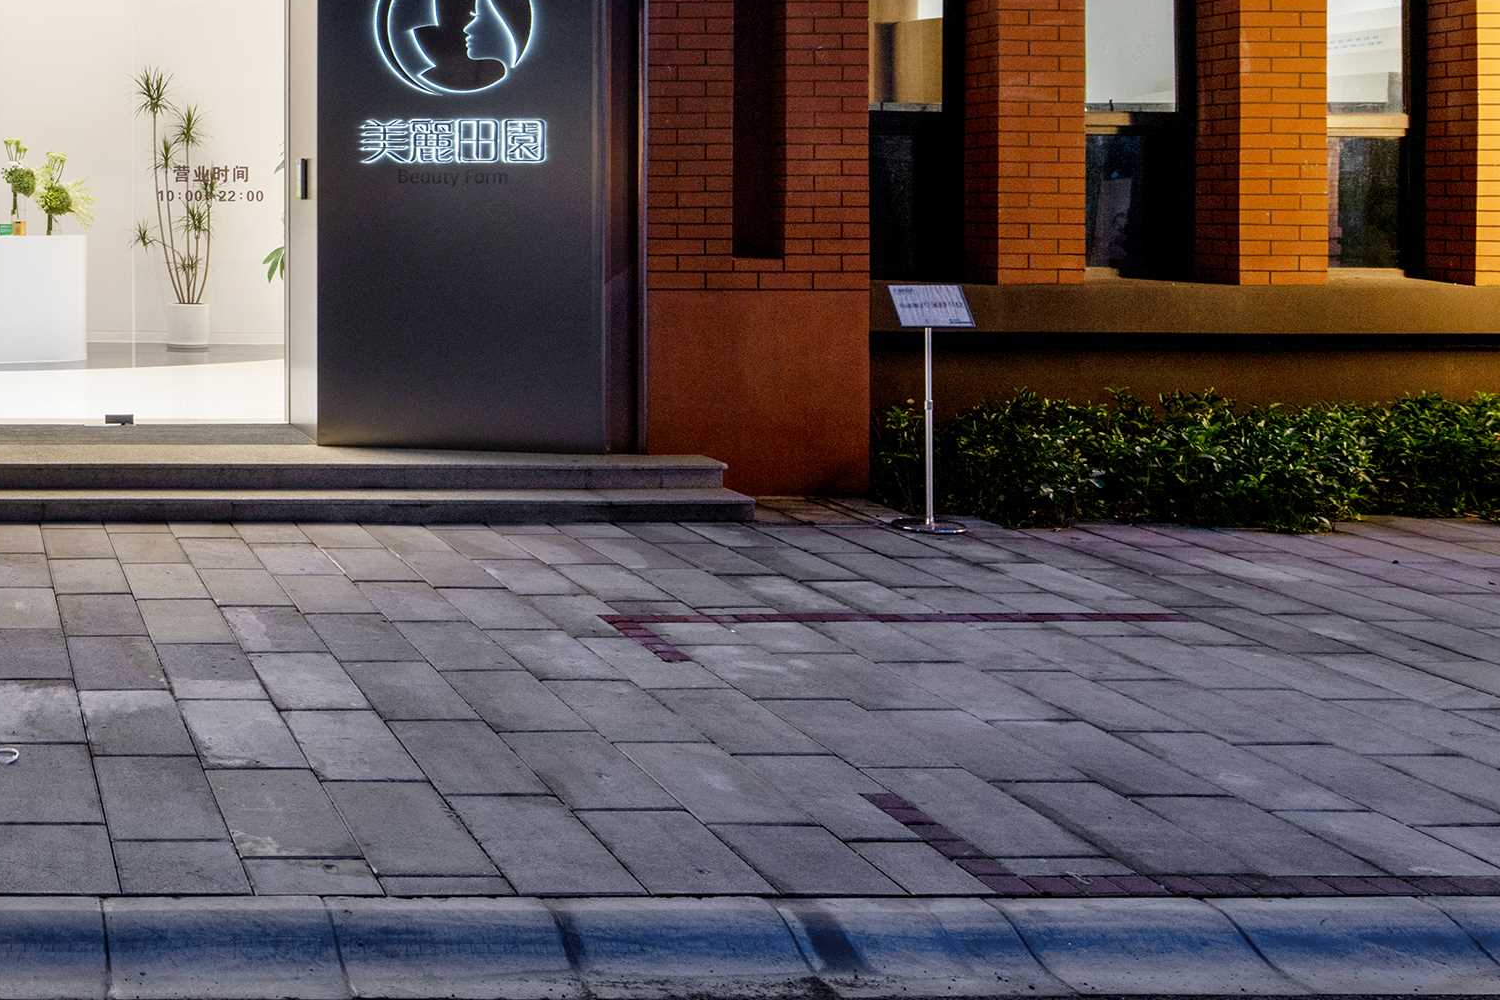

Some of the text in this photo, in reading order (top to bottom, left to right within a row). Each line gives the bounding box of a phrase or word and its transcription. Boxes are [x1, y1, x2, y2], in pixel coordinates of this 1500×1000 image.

[360, 119, 547, 164] 美麗田園
[173, 165, 249, 183] 营业时间
[398, 169, 460, 187] Beauty
